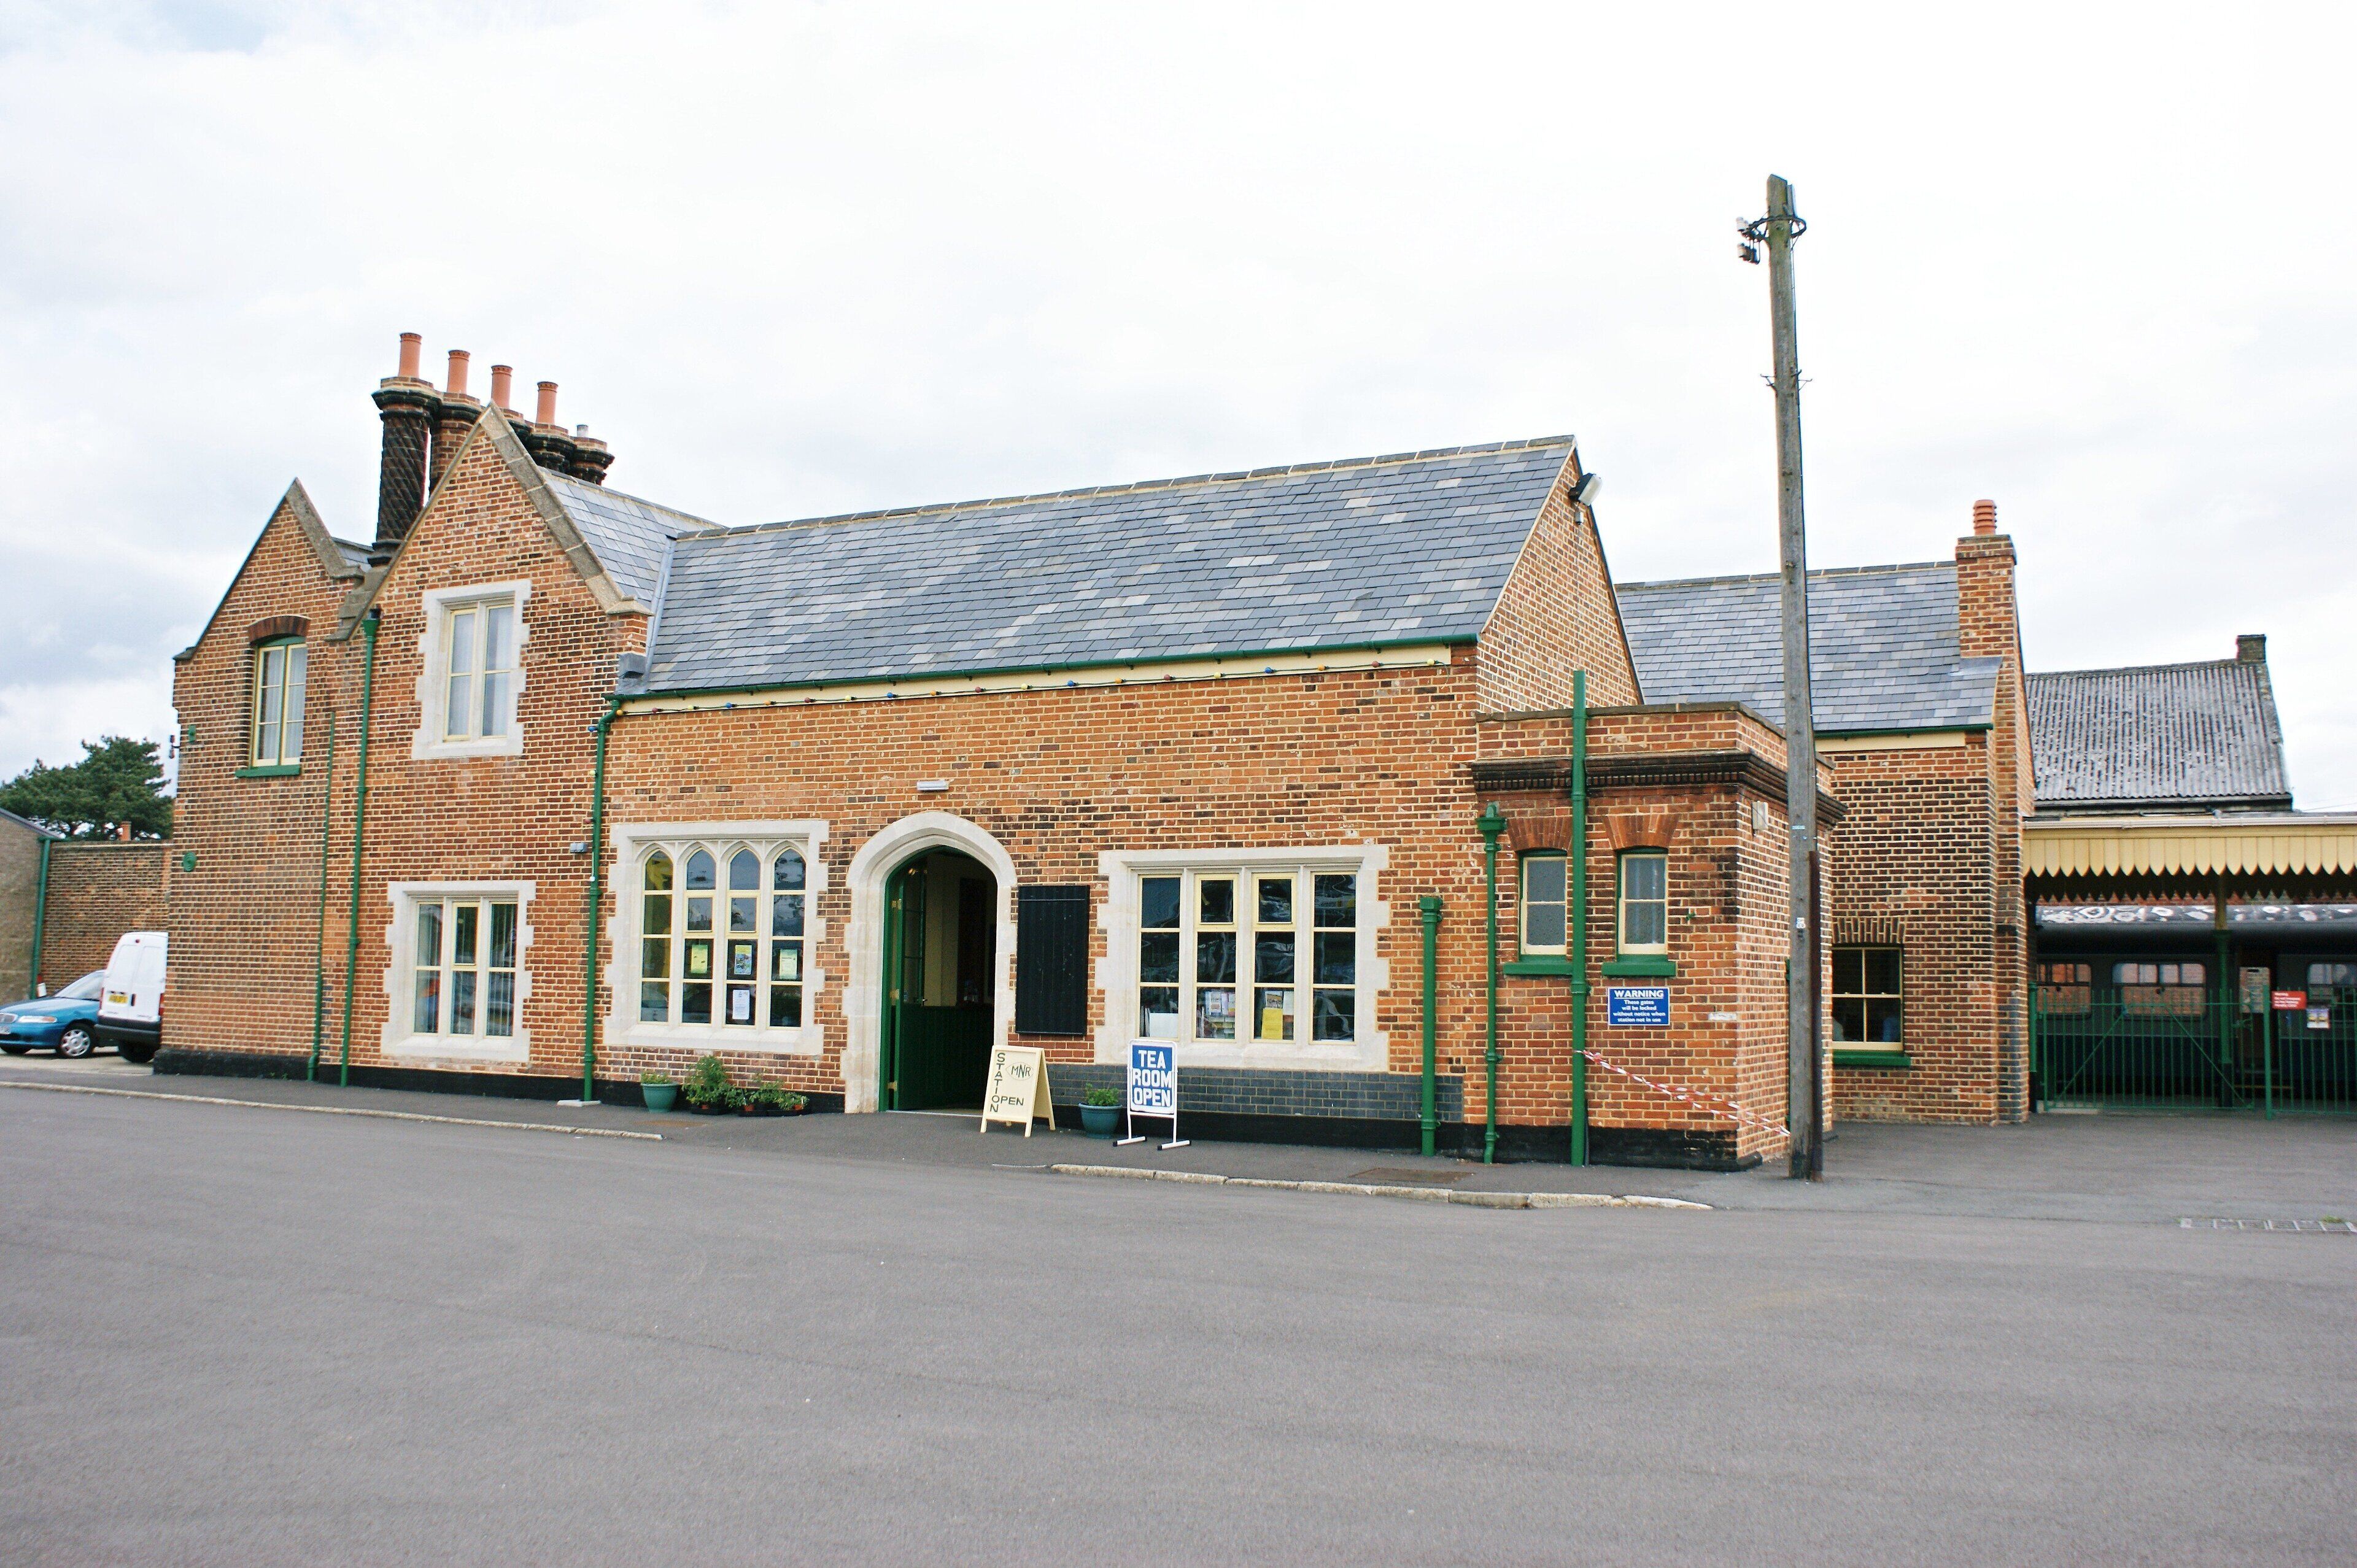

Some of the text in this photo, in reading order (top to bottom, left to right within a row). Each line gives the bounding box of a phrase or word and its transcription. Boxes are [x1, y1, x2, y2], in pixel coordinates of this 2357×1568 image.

[1138, 1049, 1166, 1069] TEA
[1010, 1064, 1032, 1078] MNR
[1132, 1068, 1172, 1089] ROOM
[989, 1052, 1006, 1113] STATION
[1133, 1087, 1171, 1107] OPEN
